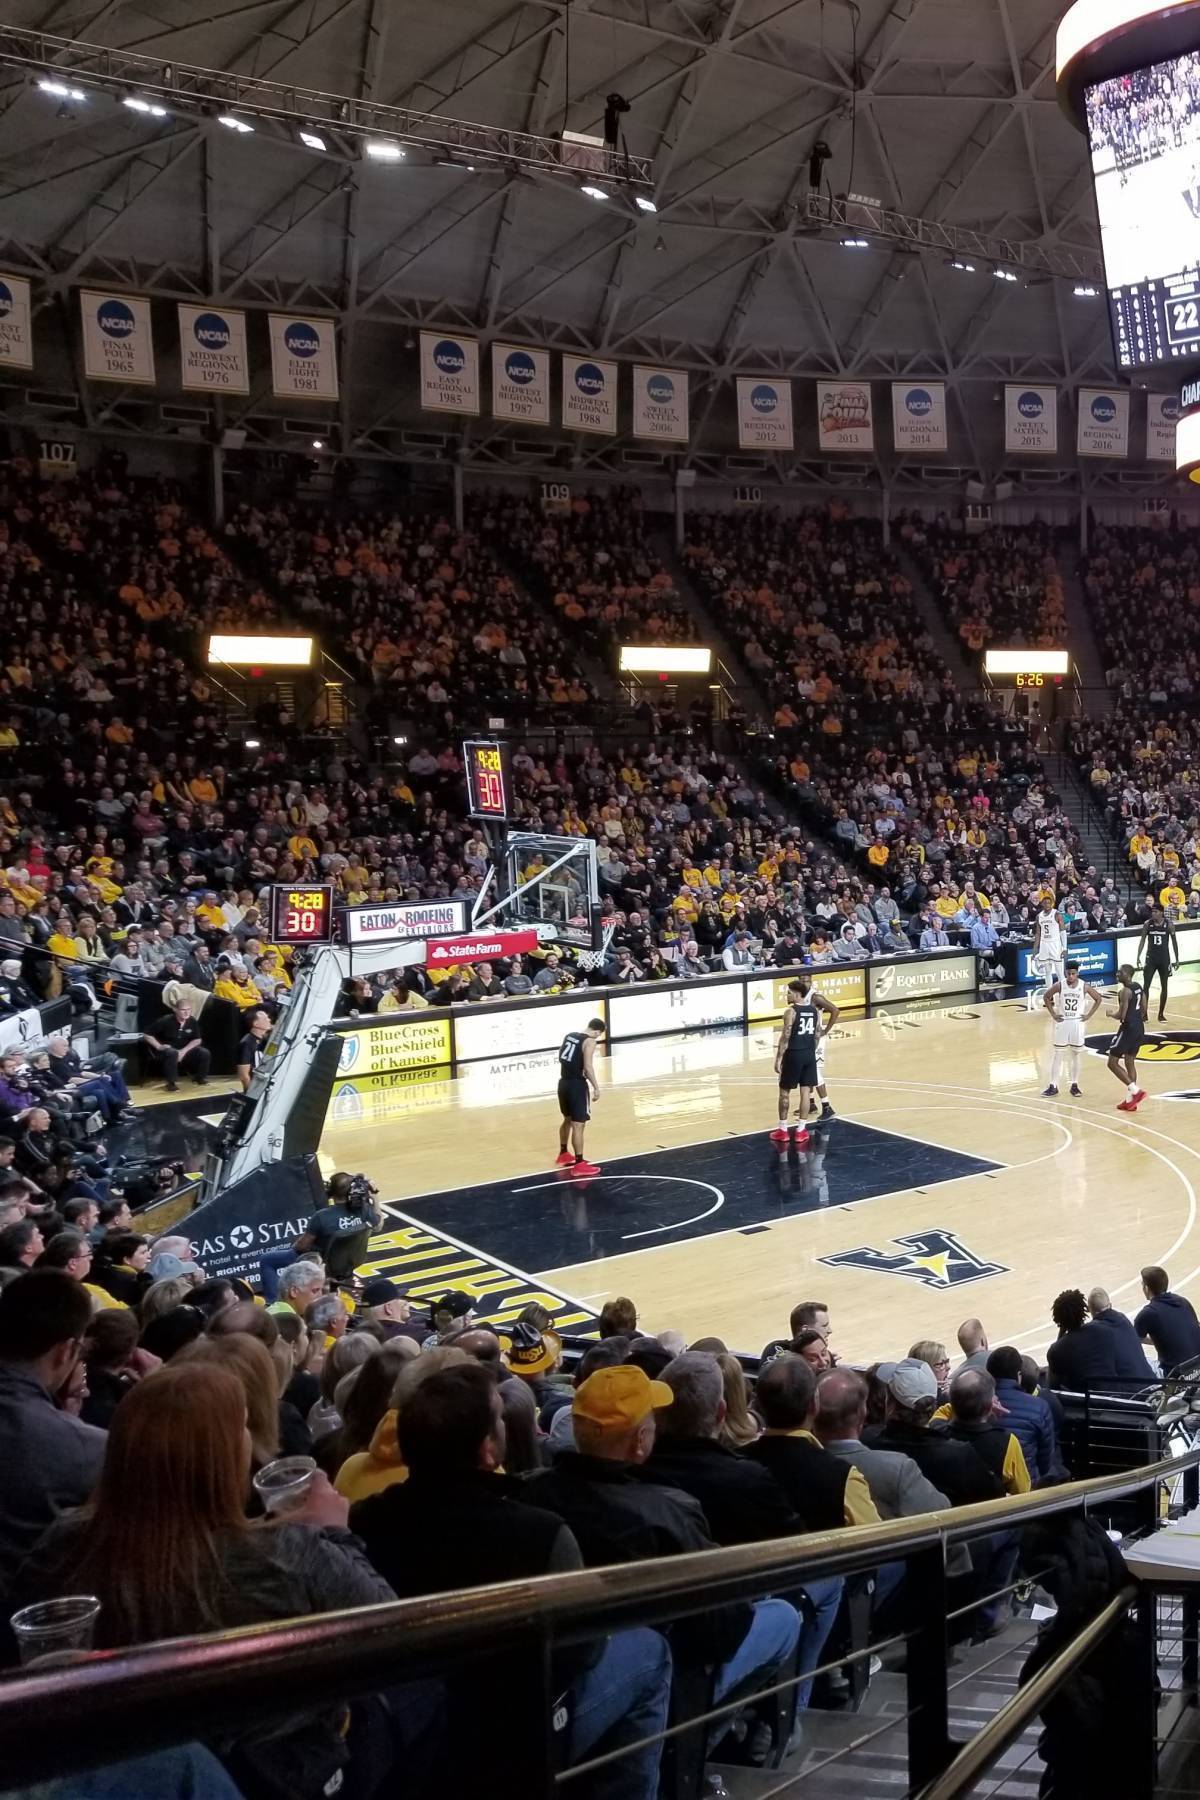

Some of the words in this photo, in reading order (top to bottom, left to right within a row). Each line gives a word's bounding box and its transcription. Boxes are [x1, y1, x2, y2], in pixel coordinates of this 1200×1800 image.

[1173, 302, 1199, 331] 22
[101, 317, 135, 330] NCAA
[198, 329, 230, 342] NCAA
[102, 340, 135, 351] FINAL
[288, 338, 320, 350] NCAA
[104, 349, 135, 359] FOUR
[190, 351, 239, 362] MIDWEST
[106, 359, 135, 373] 1965
[187, 359, 243, 372] REGIONAL
[288, 359, 320, 370] ELITE
[436, 355, 465, 367] NCAA
[201, 370, 230, 384] 1976
[288, 368, 321, 378] EIGHT
[508, 365, 537, 378] NCAA
[293, 378, 319, 391] 1981
[426, 380, 473, 394] REGIONAL
[438, 375, 462, 386] EAST
[577, 376, 605, 388] NCAA
[439, 392, 463, 405] 1985
[509, 402, 533, 415] 1987
[579, 412, 601, 425] 1988
[754, 431, 777, 441] 2012
[1020, 436, 1042, 446] 2015
[1083, 431, 1124, 440] REGIONAL
[40, 442, 75, 461] 107
[1091, 440, 1113, 450] 2016
[540, 483, 570, 499] 109
[735, 487, 762, 501] 110
[965, 504, 992, 519] 111
[1144, 499, 1169, 512] 112
[1016, 673, 1044, 686] 6:26
[478, 751, 500, 771] 9:28
[478, 772, 501, 808] 30
[289, 893, 323, 910] 9:28
[287, 912, 316, 933] 30
[360, 912, 397, 930] EATON
[405, 907, 454, 926] ROOFING
[405, 923, 455, 937] EXTERIORS
[1153, 935, 1163, 945] 13
[823, 975, 861, 987] HEALTH
[896, 971, 936, 988] EQUITY
[940, 968, 970, 982] BANK
[1064, 999, 1078, 1011] 52
[797, 1017, 816, 1035] 34
[370, 1026, 439, 1042] BlueCross
[371, 1037, 445, 1057] BlueShield
[560, 1041, 576, 1062] 21
[371, 1060, 385, 1071] of
[388, 1053, 437, 1068] Kansas
